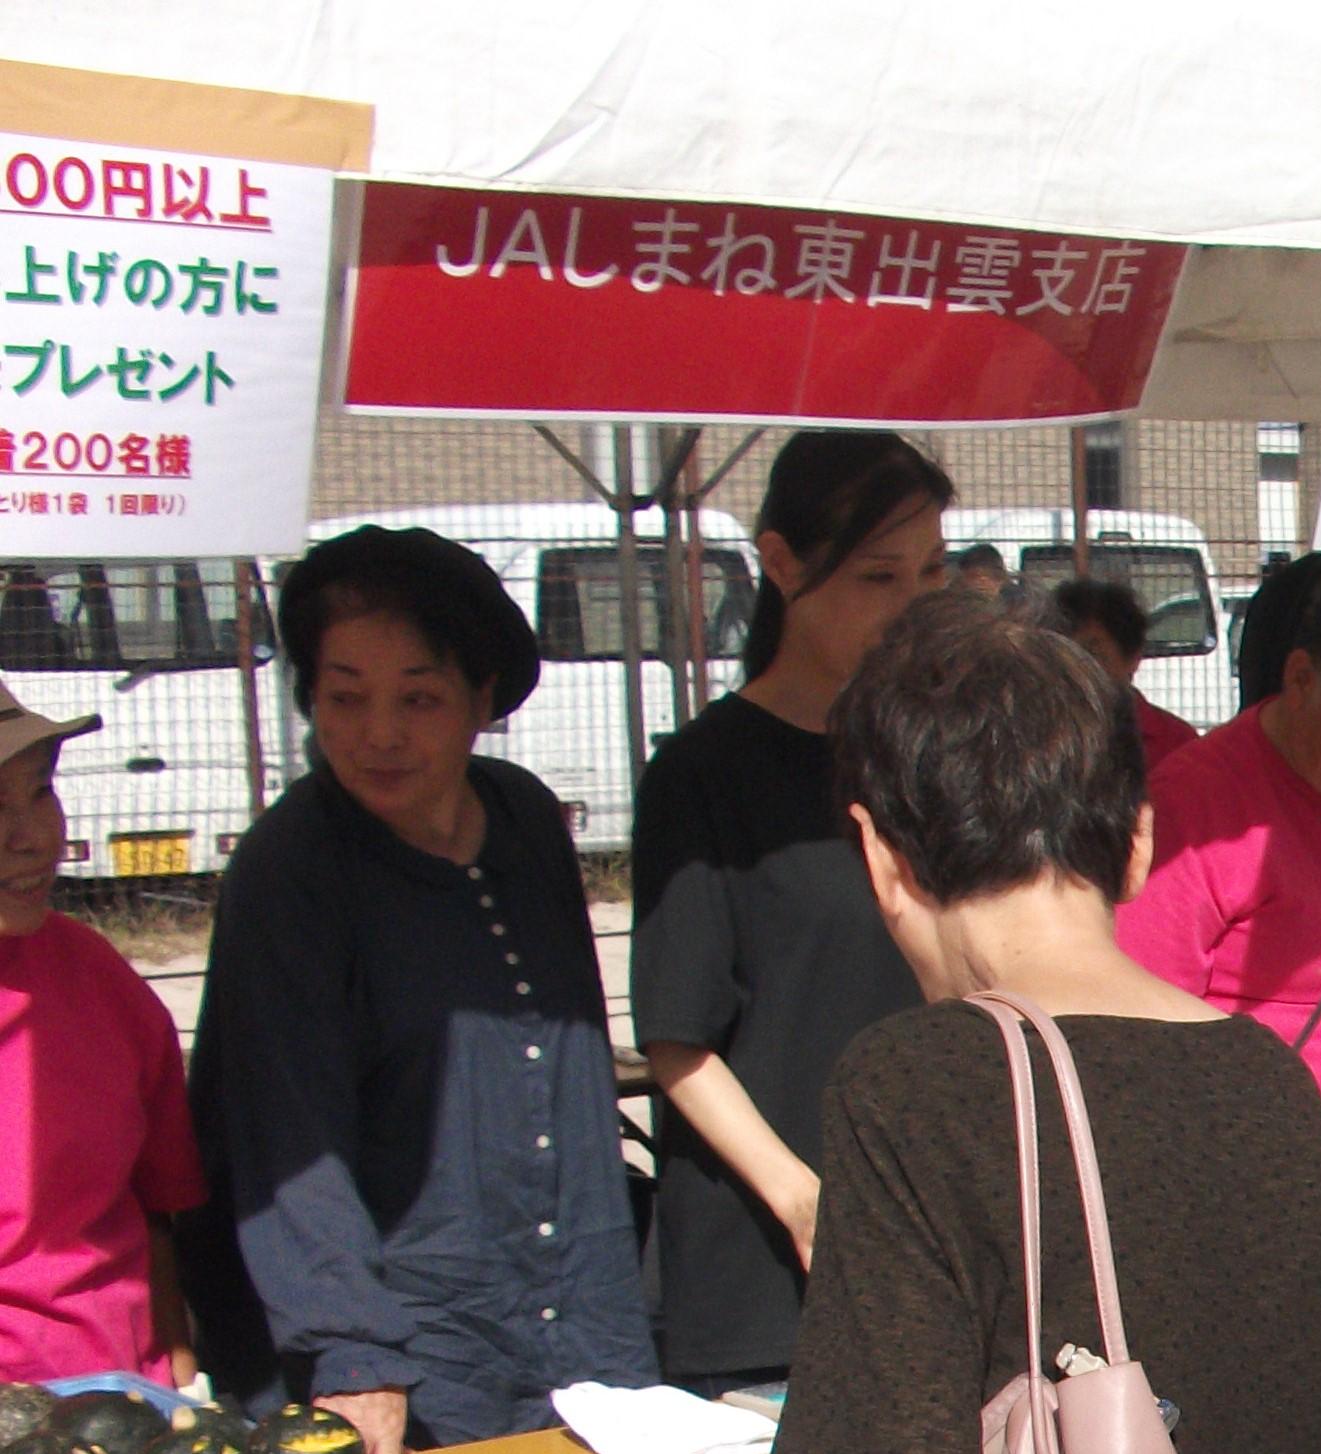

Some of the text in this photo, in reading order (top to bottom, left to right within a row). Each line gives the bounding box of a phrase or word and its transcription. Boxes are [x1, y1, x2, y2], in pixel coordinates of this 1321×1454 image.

[0, 153, 272, 227] 00円以上
[437, 206, 1143, 317] JAしまね東出雲支店
[0, 338, 236, 406] プレゼント
